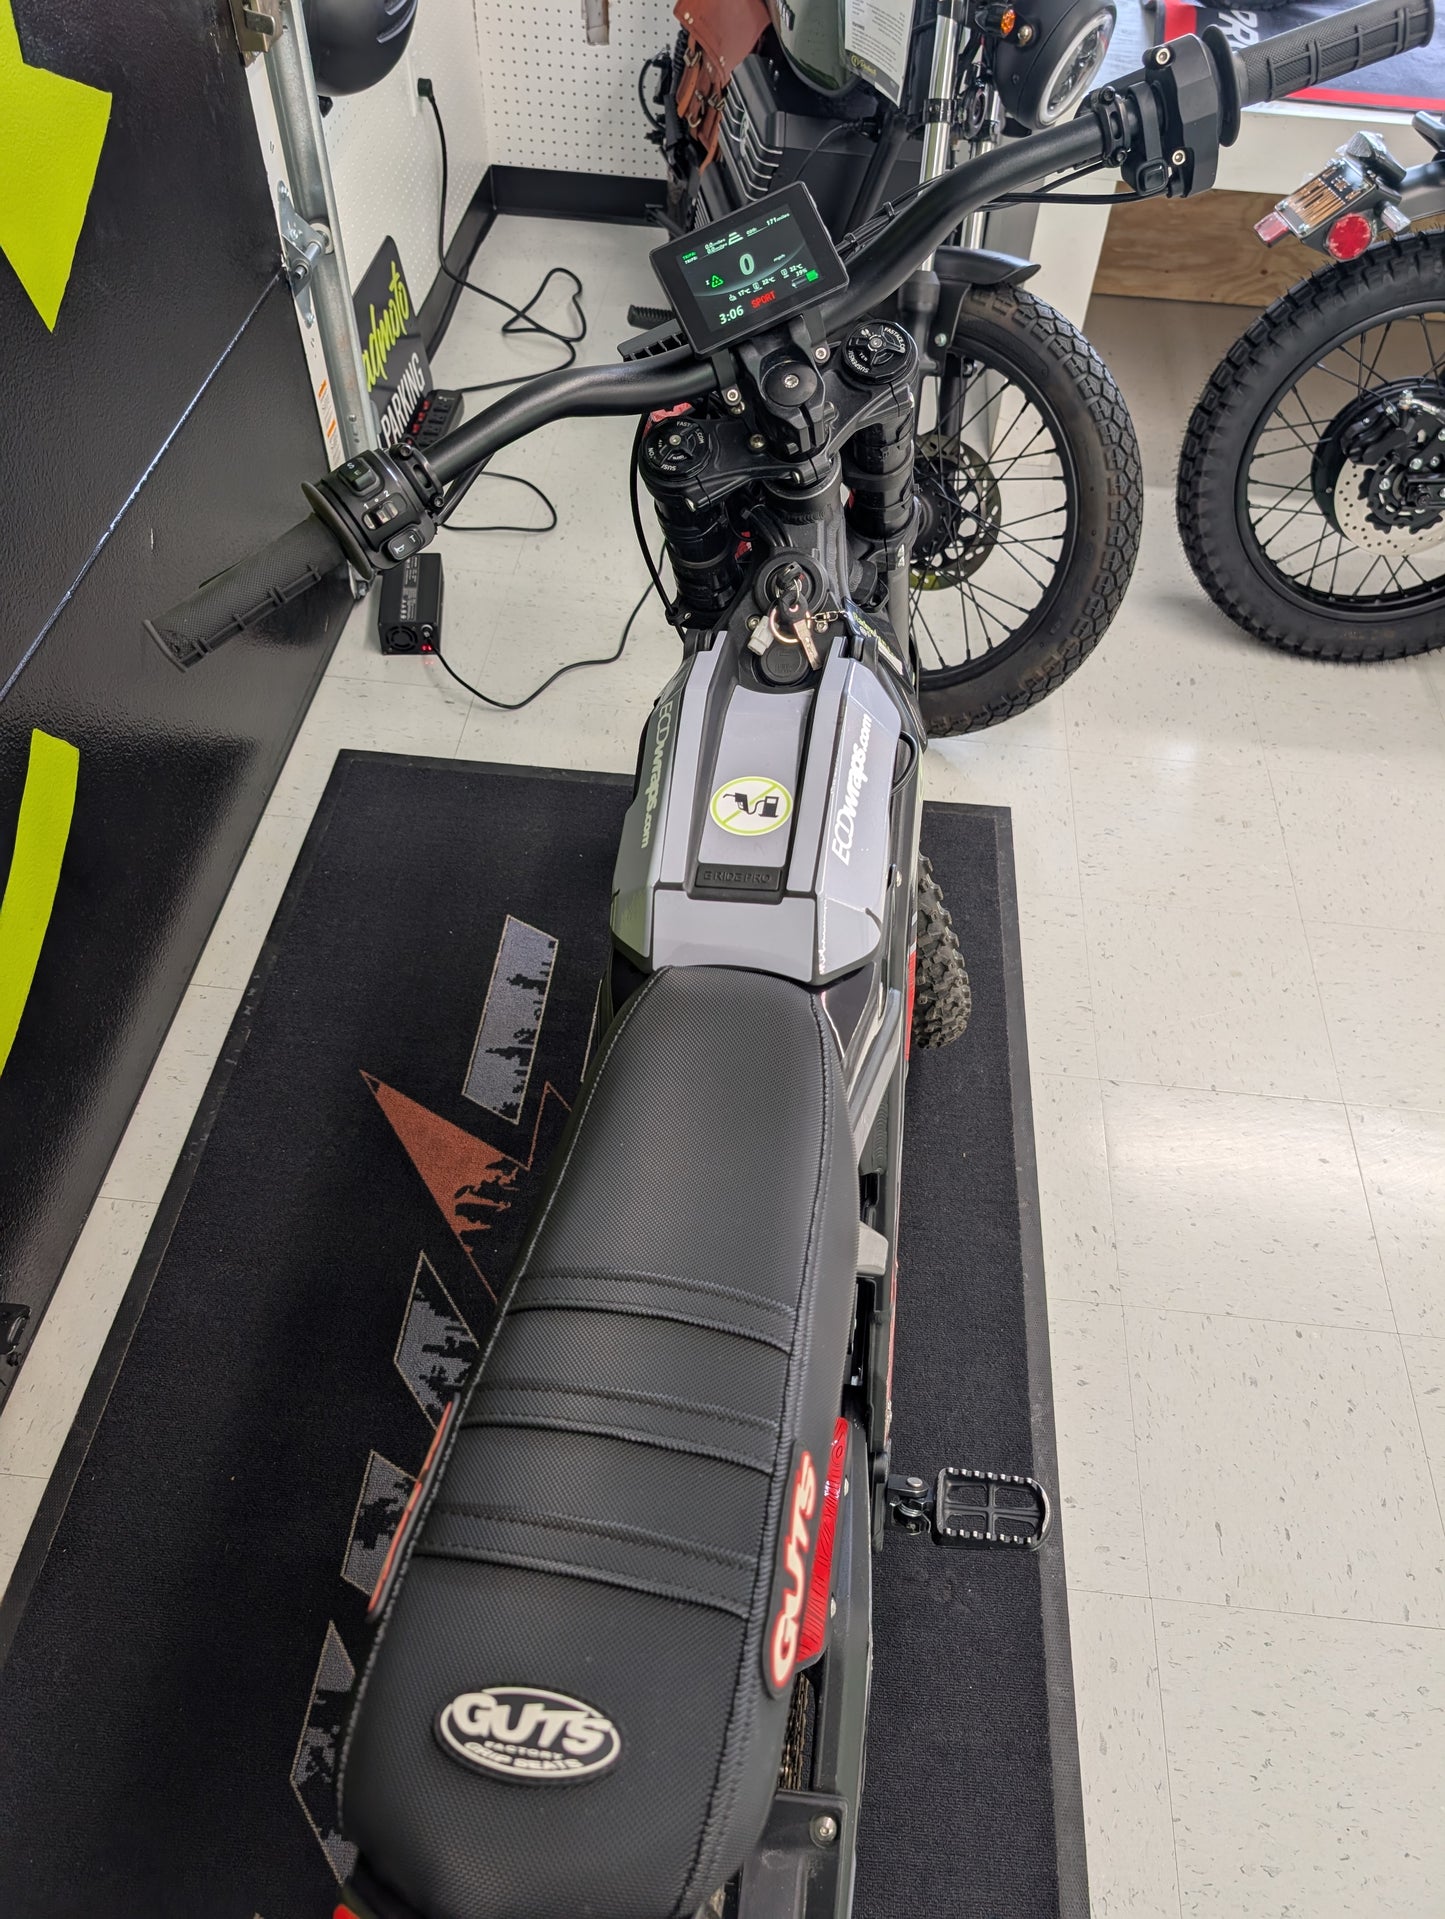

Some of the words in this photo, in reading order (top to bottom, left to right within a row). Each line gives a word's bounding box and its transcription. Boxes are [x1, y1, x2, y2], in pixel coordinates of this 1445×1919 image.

[1217, 9, 1259, 53] PR
[739, 253, 755, 276] 0
[751, 289, 777, 309] SPORT
[719, 304, 745, 325] 3:06
[381, 352, 426, 450] PARKING
[383, 489, 391, 498] 2
[714, 870, 743, 882] RIDE
[744, 871, 771, 884] PRO
[773, 1452, 817, 1685] GUTS
[452, 1692, 613, 1756] GUTS
